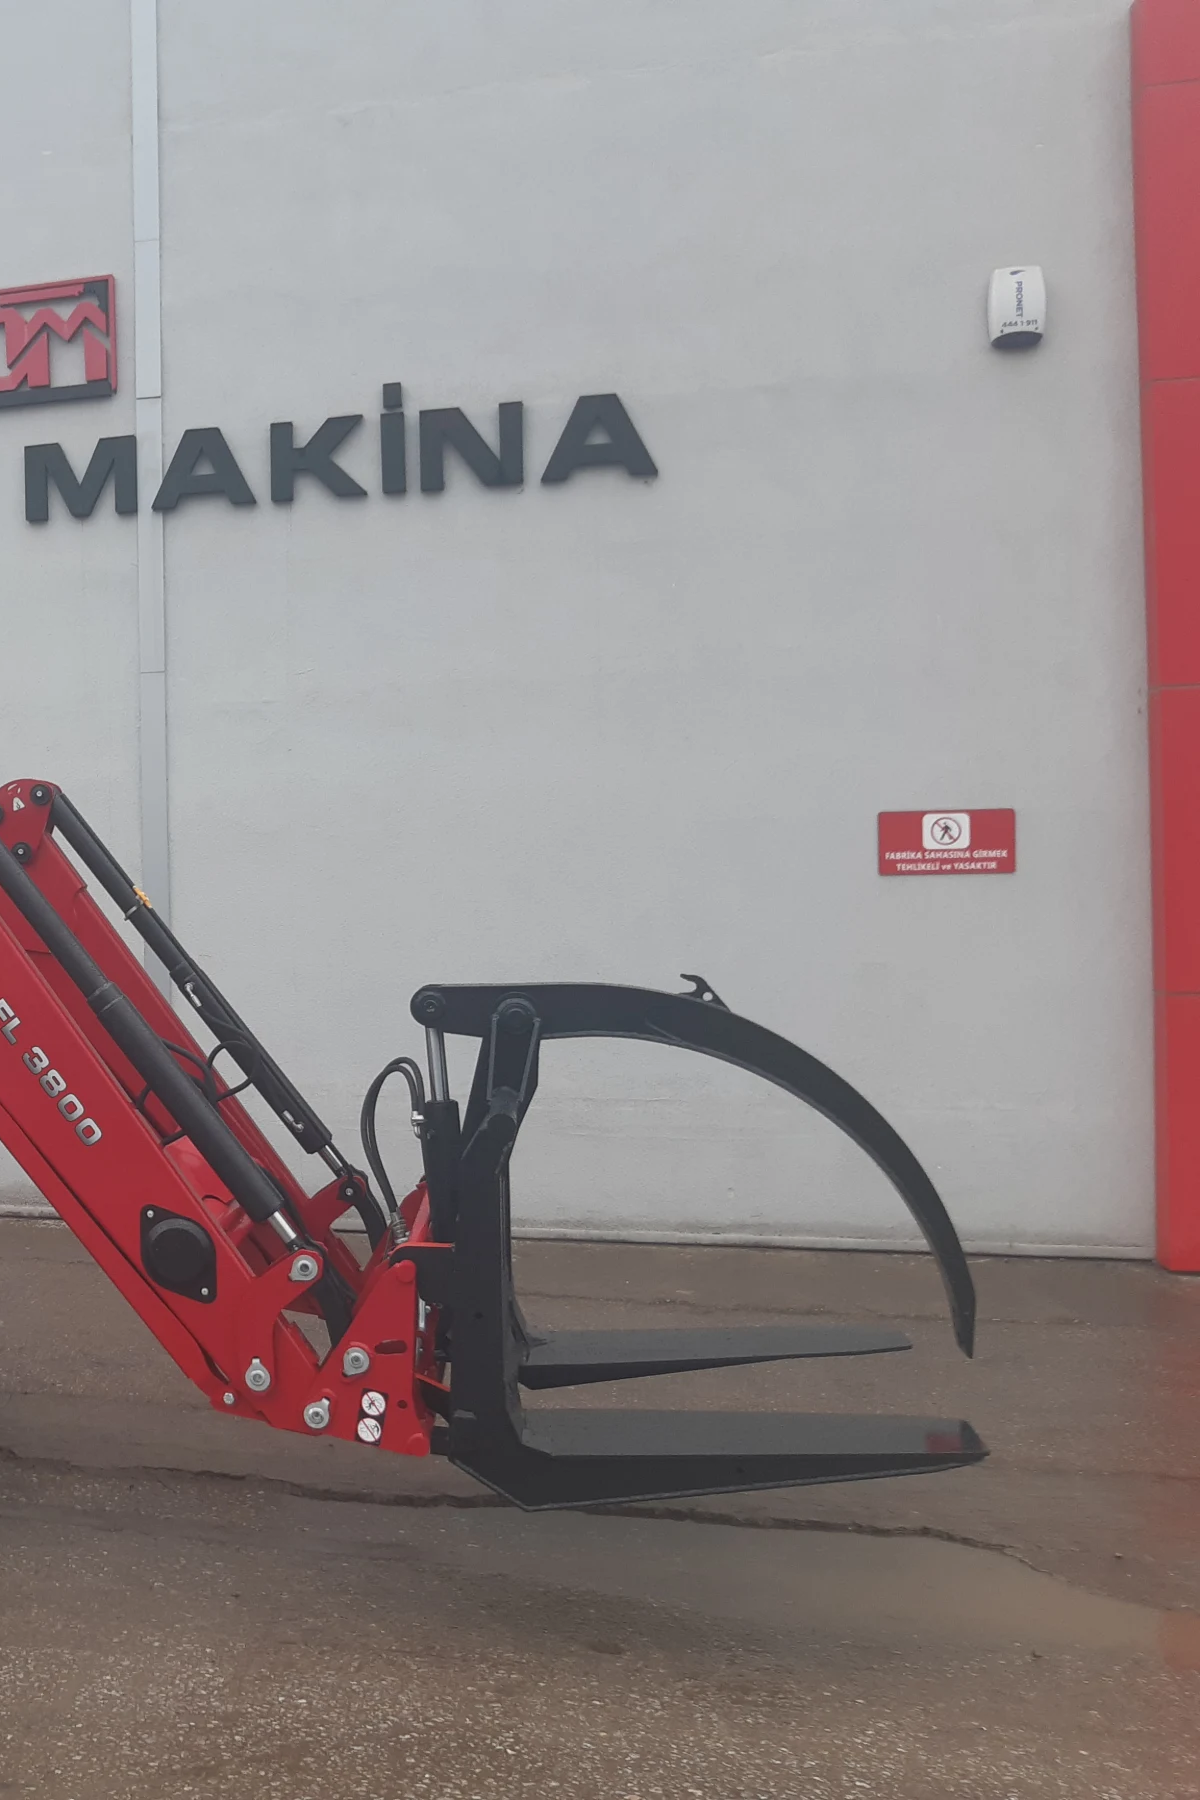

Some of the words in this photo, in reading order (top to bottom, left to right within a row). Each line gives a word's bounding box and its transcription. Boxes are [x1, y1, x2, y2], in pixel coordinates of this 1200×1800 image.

[1015, 281, 1023, 318] PRONET
[23, 382, 659, 523] MAKİNA
[885, 851, 922, 860] FABRİKA
[924, 850, 970, 860] SAHASINA
[972, 849, 1008, 858] GİRMEK
[896, 861, 940, 871] TEHLİKELİ
[953, 861, 997, 870] YASAKTIR
[22, 1045, 103, 1147] 3800
